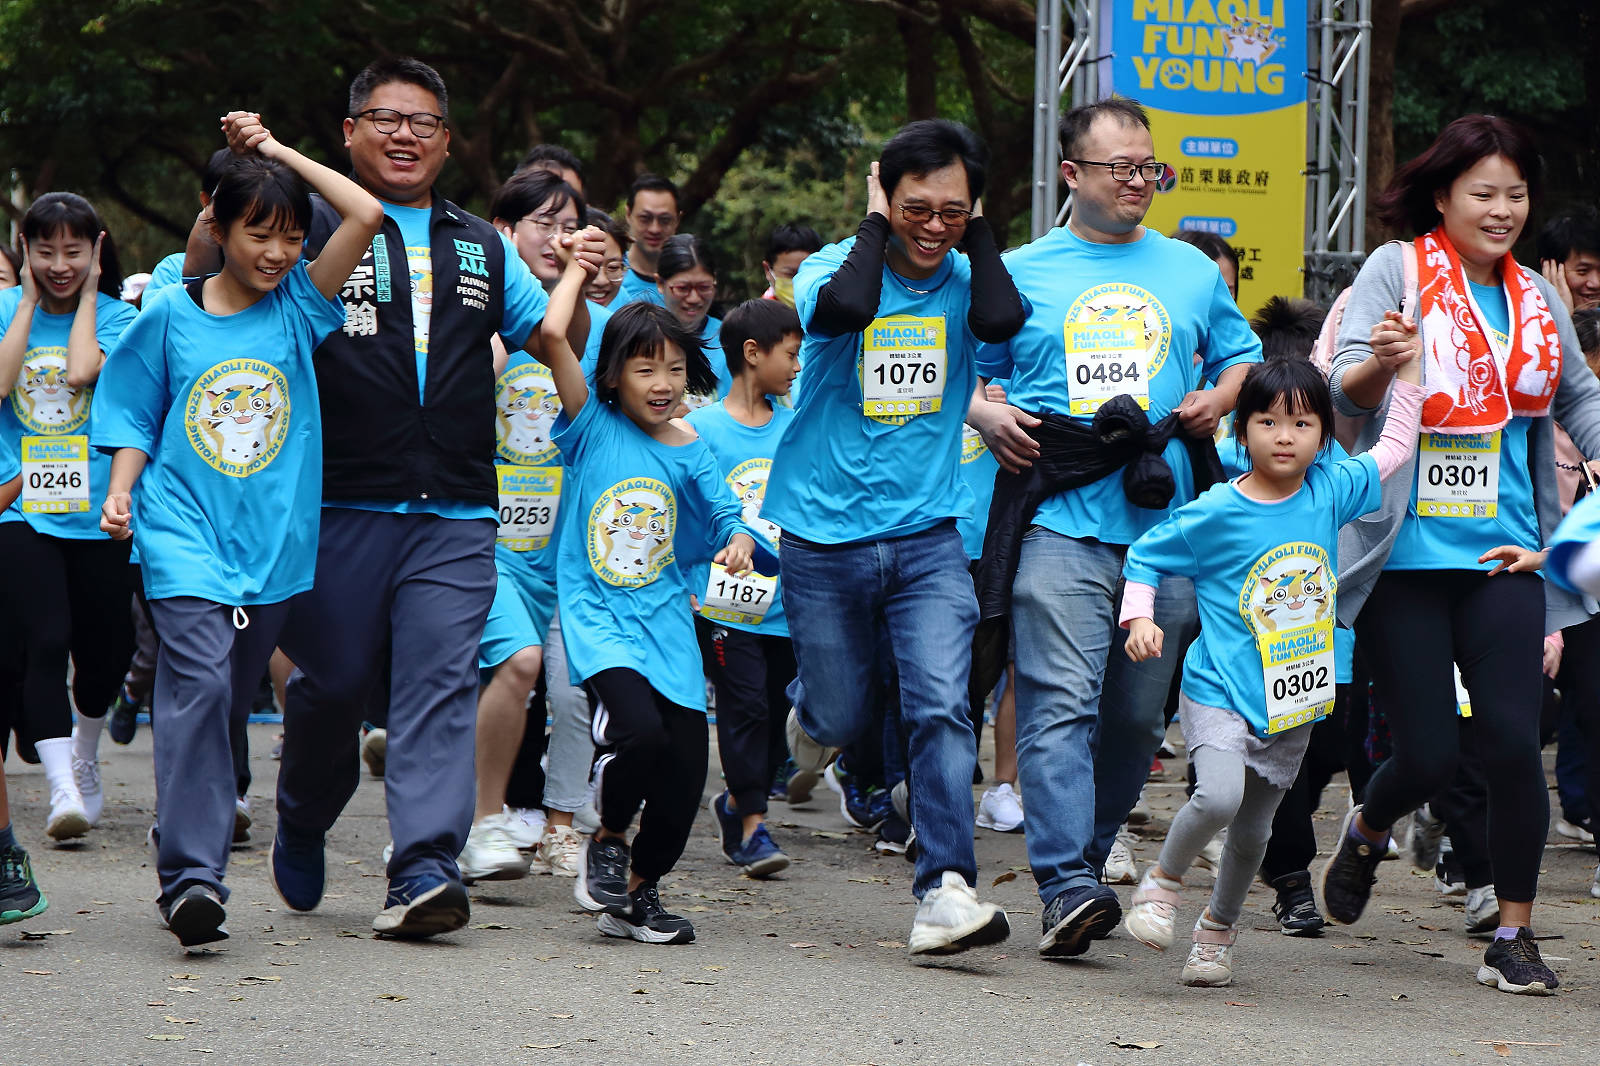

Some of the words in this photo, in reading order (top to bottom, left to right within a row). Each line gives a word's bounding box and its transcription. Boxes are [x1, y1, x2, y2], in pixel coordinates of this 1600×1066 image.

[1132, 0, 1286, 28] MIAOLI
[1142, 24, 1226, 57] FUN
[1132, 56, 1287, 95] YOUNG
[1180, 167, 1270, 187] 苗栗縣政府
[341, 245, 378, 337] 宗翰
[459, 275, 490, 291] TAIWAN
[1121, 285, 1146, 299] FUN
[462, 297, 487, 311] PARTY
[1080, 285, 1120, 305] MIAOLI
[1147, 297, 1169, 334] YOUNG
[872, 328, 927, 338] MIAOLI
[872, 338, 897, 347] FUN
[898, 337, 937, 347] YOUNG
[1073, 330, 1125, 342] MIAOLI
[1073, 340, 1097, 350] FUN
[1154, 336, 1169, 367] 2025
[199, 362, 242, 389] MIAOLI
[244, 361, 270, 376] FUN
[504, 365, 540, 384] MIAOLI
[873, 362, 937, 385] 1076
[1076, 361, 1140, 385] 0484
[187, 390, 202, 423] 2025
[28, 444, 72, 453] MIAOLI
[188, 425, 217, 465] YOUNG
[1429, 440, 1453, 449] FUN
[1454, 440, 1492, 449] YOUNG
[218, 461, 244, 475] FUN
[730, 460, 763, 481] MIAOLI
[1428, 464, 1489, 487] 0301
[29, 471, 82, 488] 0246
[502, 474, 547, 486] MIAOLI
[612, 480, 655, 497] MIAOLI
[655, 484, 672, 501] FUN
[501, 505, 550, 525] 0253
[599, 565, 621, 584] FUN
[1241, 577, 1256, 611] 2025
[1254, 545, 1295, 576] MIAOLI
[1297, 544, 1321, 558] FUN
[716, 580, 768, 605] 1187
[1269, 633, 1317, 655] MIAOLI
[1270, 651, 1292, 664] FUN
[1293, 642, 1326, 657] YOUNG
[1273, 666, 1329, 701] 0302
